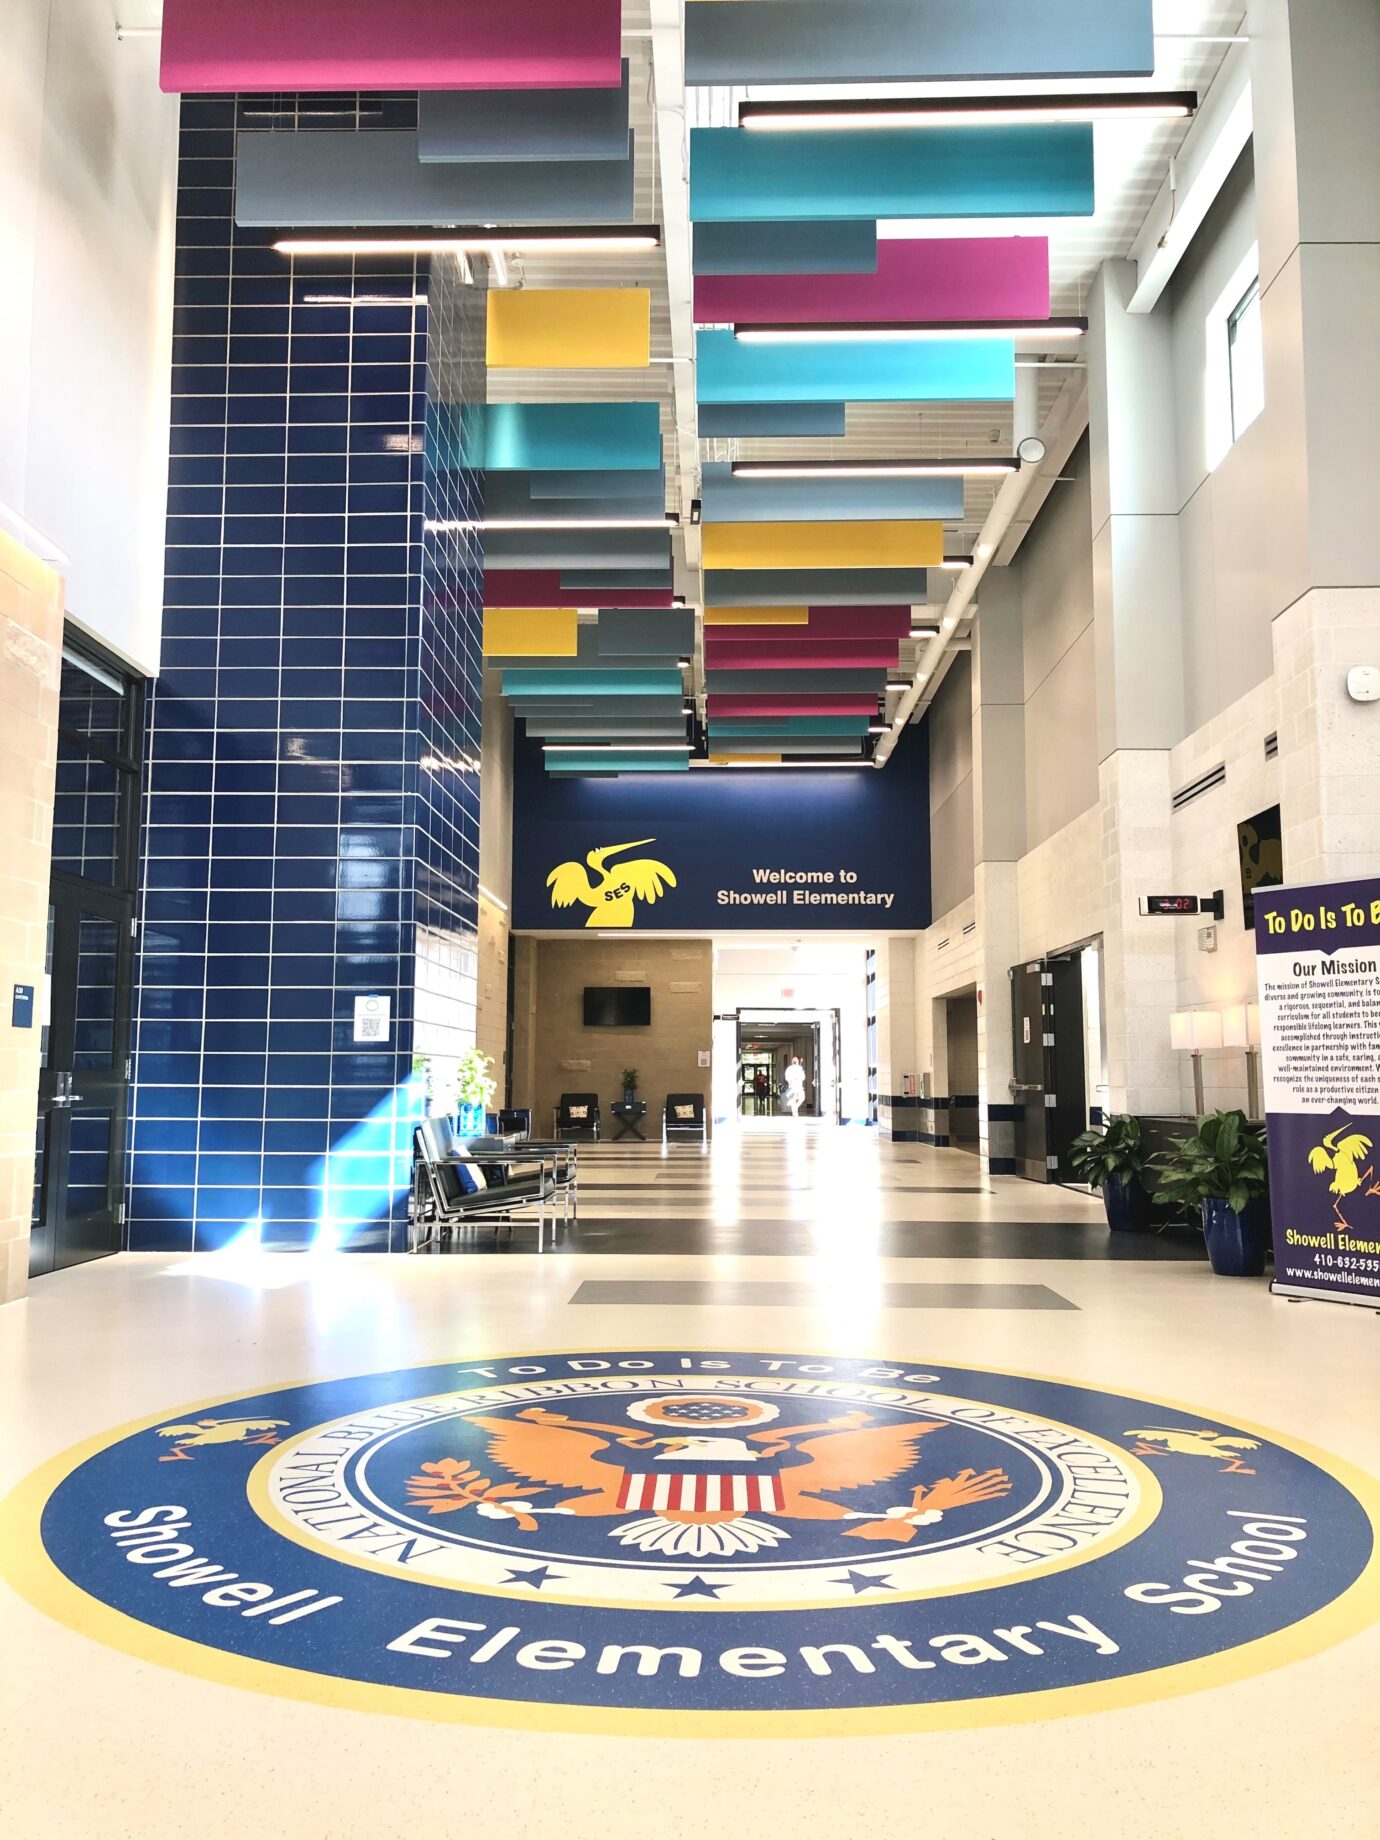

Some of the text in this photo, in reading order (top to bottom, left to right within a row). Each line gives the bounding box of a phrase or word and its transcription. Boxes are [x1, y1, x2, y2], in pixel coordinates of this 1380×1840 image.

[752, 869, 858, 884] Welcome to
[604, 882, 631, 902] SES
[717, 890, 895, 908] Showell Elementary
[1264, 911, 1286, 934] To
[1290, 908, 1315, 932] Do
[1320, 906, 1337, 930] Is
[1340, 902, 1365, 927] To
[1293, 959, 1377, 977] Our Mission
[1265, 983, 1275, 991] The
[1301, 981, 1308, 989] of
[1309, 980, 1334, 988] Showell
[1335, 978, 1373, 987] Elementary
[1265, 993, 1286, 1001] diverse
[1287, 992, 1298, 1000] and
[1300, 991, 1326, 1000] growing
[1366, 988, 1371, 996] is
[1348, 999, 1360, 1008] and
[1277, 1010, 1380, 1021] curriculum for all students to be
[1274, 1023, 1306, 1032] responsible
[1308, 1022, 1332, 1031] lifelong
[1364, 1020, 1378, 1028] This
[1281, 1033, 1320, 1042] accomplished
[1322, 1032, 1347, 1041] through
[1273, 1043, 1303, 1052] excellence
[1304, 1043, 1310, 1051] in
[1311, 1042, 1349, 1052] partnership
[1350, 1042, 1366, 1050] with
[1286, 1054, 1320, 1062] community
[1322, 1053, 1328, 1061] in
[1273, 1075, 1303, 1083] recognize
[1304, 1074, 1314, 1082] the
[1315, 1075, 1350, 1084] uniqueness
[1351, 1075, 1358, 1083] of
[1360, 1075, 1376, 1083] each
[1292, 1085, 1304, 1093] role
[1320, 1085, 1354, 1094] productive
[1356, 1085, 1379, 1093] citizen
[1311, 1096, 1356, 1105] ever-changing
[1286, 1228, 1335, 1250] Showell
[457, 1358, 941, 1383] To Do Is To Be
[280, 1379, 1130, 1564] NATIONAL BLUE RIBBON SCHOOL OF EXCELLENCE
[103, 1505, 1307, 1678] Showell Elementary School
